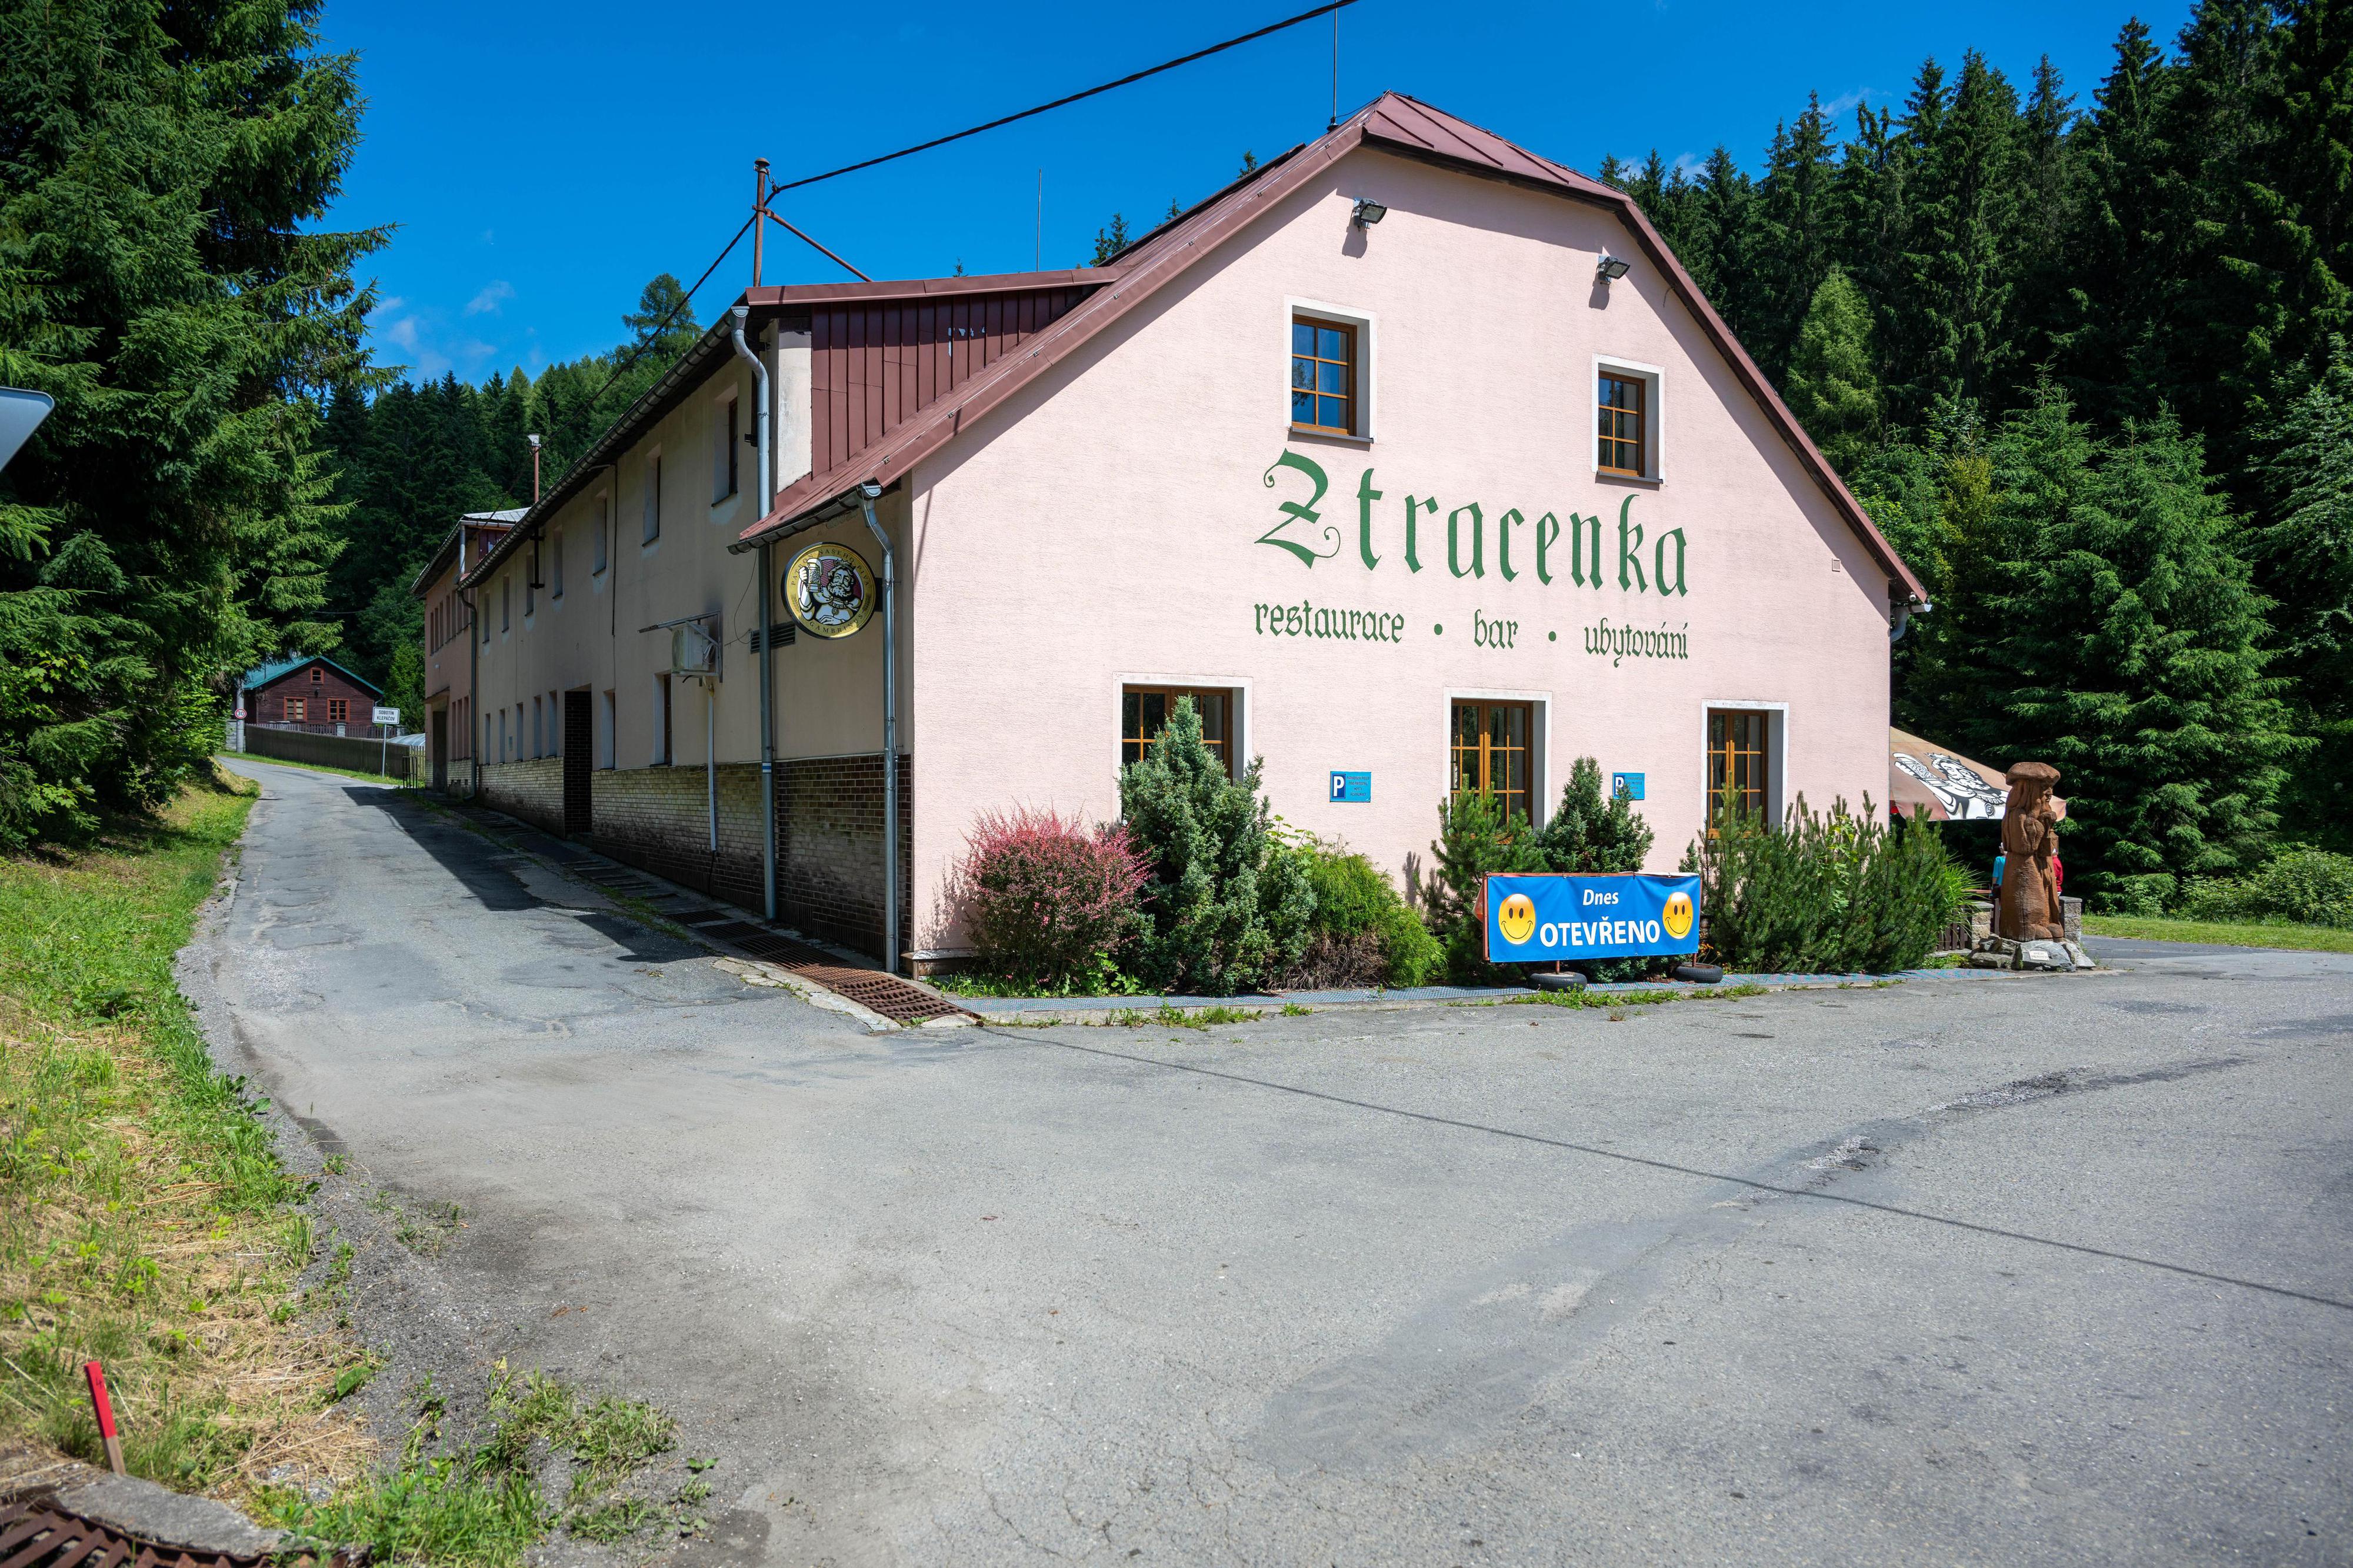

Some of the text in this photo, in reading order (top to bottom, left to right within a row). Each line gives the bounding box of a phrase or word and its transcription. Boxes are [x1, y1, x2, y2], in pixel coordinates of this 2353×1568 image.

[1254, 448, 1688, 597] Ztracenka
[809, 614, 863, 634] GAMBRINUS
[1254, 600, 1689, 668] restaurace bar ubytování
[1334, 776, 1344, 796] P
[1582, 889, 1619, 906] Dnes
[1539, 916, 1660, 948] OTEVŘENO
